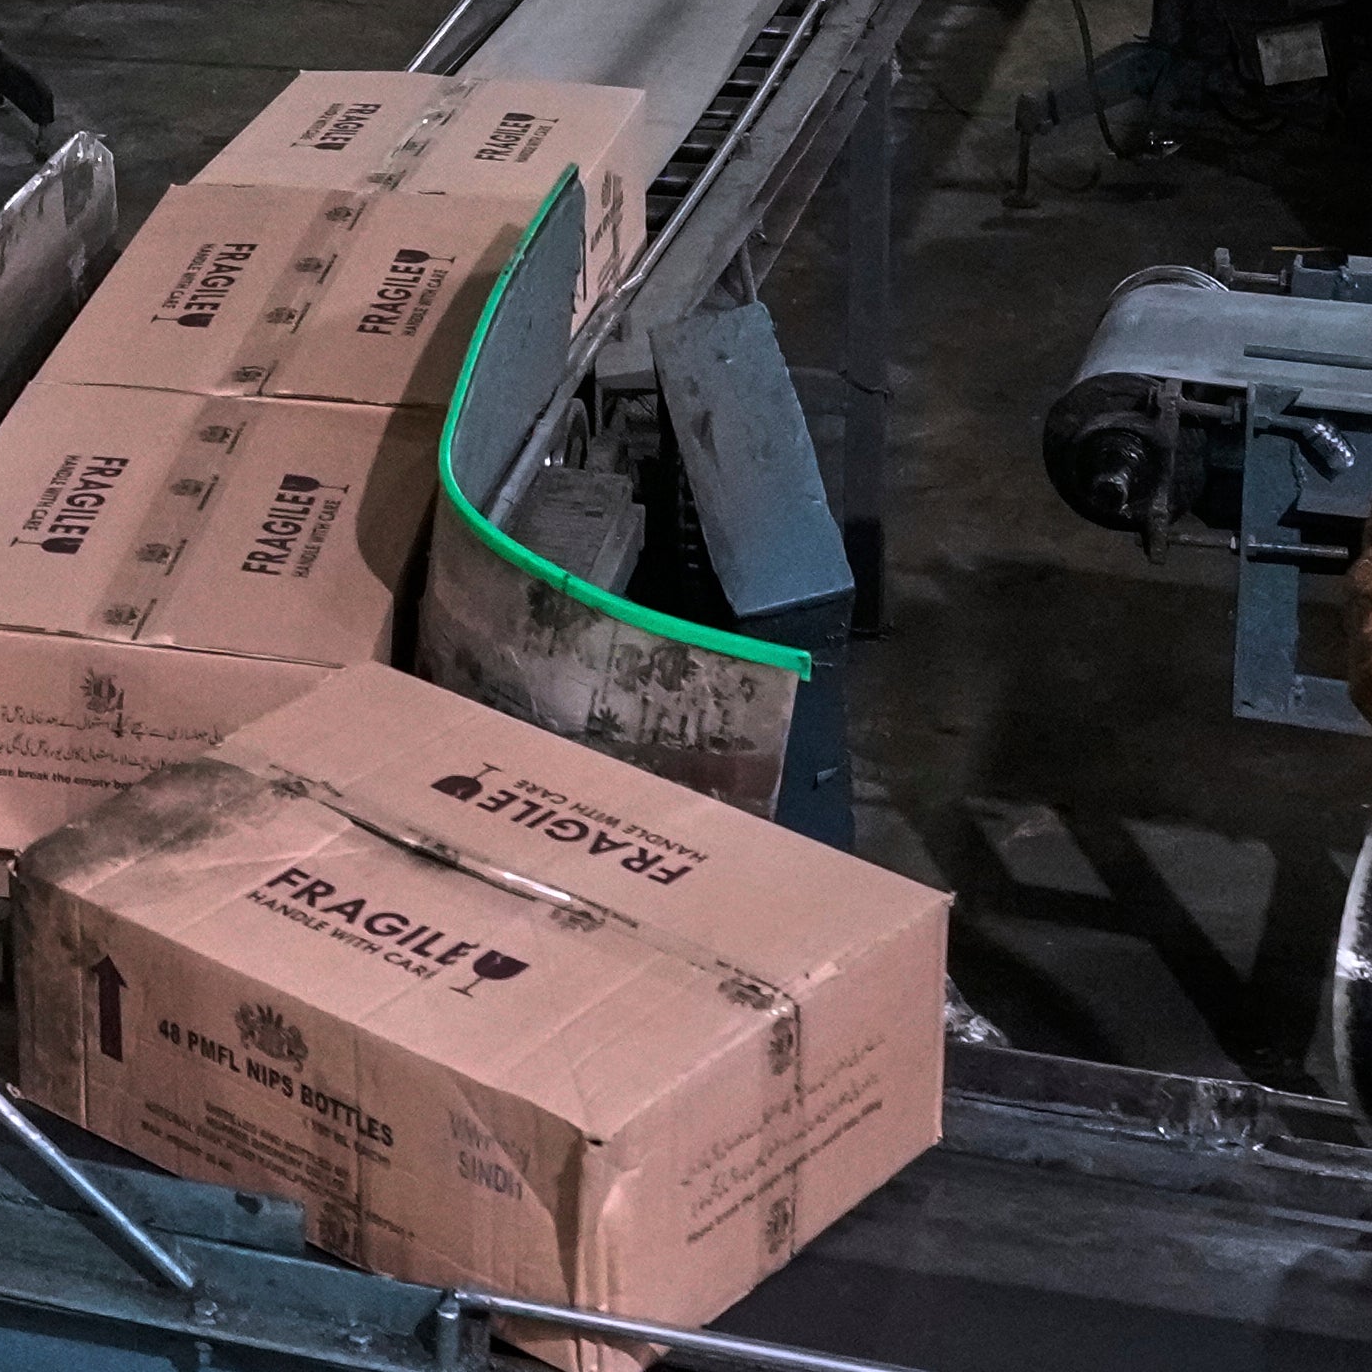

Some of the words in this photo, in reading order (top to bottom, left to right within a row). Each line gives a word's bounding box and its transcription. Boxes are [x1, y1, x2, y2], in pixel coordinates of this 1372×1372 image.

[320, 103, 381, 141] FRAGILE
[474, 121, 532, 161] FRAGILE
[184, 243, 259, 311] FRAGILE
[356, 264, 427, 336] FRAGILE
[50, 454, 81, 485] HANDLE
[48, 456, 129, 536] FRAGILE
[318, 499, 341, 522] CARE
[22, 509, 48, 531] CARE
[241, 492, 316, 576] FRAGILE
[18, 766, 49, 782] break
[52, 772, 71, 784] the
[73, 776, 111, 791] empty
[513, 779, 568, 805] CARE
[569, 801, 622, 829] WITH
[476, 789, 694, 886] FRAGILE
[622, 824, 709, 864] HANDLE
[247, 890, 331, 933] HANDLE
[330, 927, 379, 955] WITH
[266, 867, 480, 966] FRAGILE
[158, 1018, 182, 1046] 48
[188, 1030, 241, 1074] PMFL
[246, 1057, 295, 1099] NIPS
[300, 1082, 395, 1148] BOTTLES
